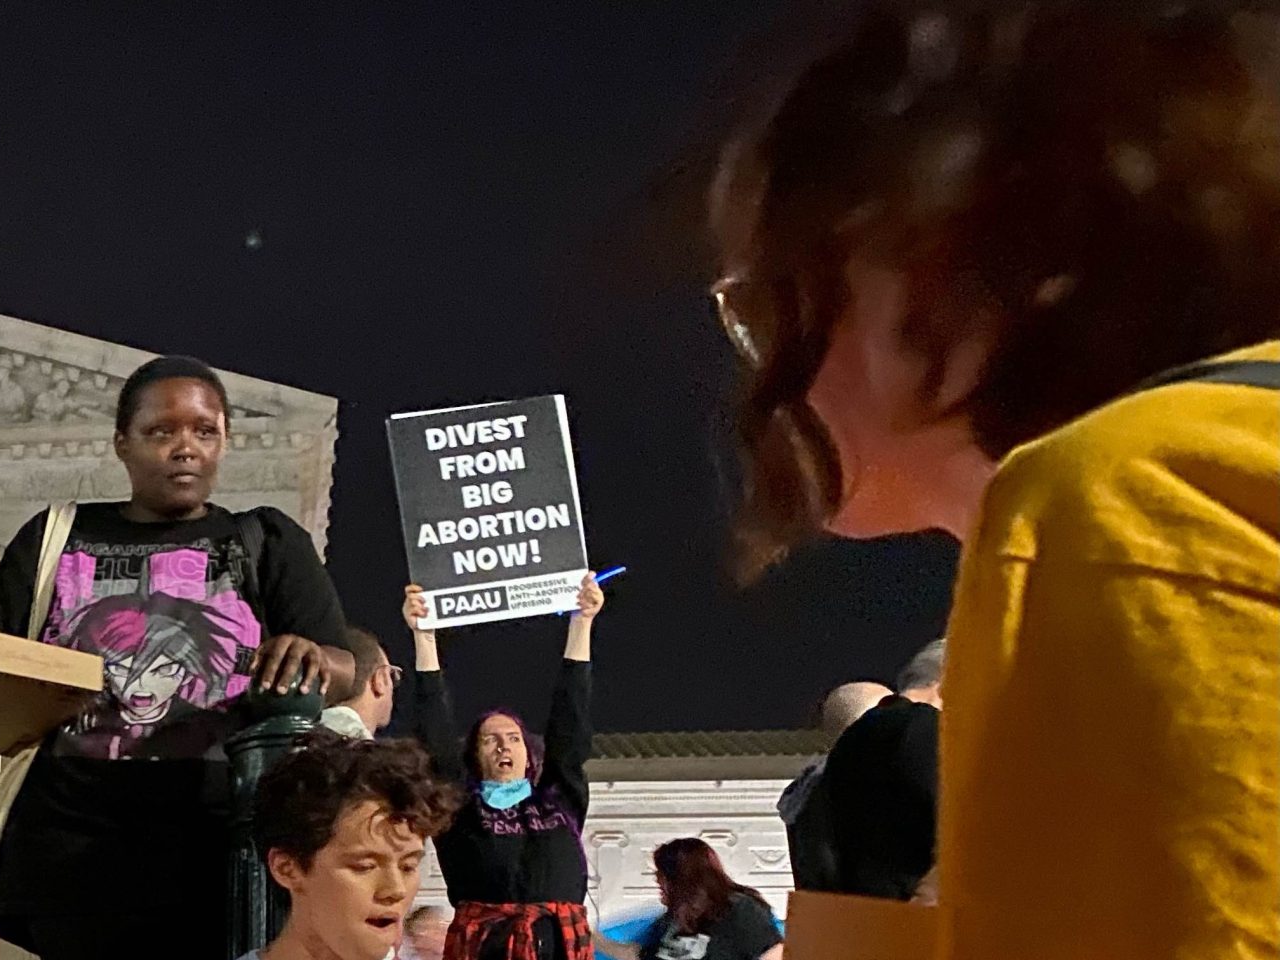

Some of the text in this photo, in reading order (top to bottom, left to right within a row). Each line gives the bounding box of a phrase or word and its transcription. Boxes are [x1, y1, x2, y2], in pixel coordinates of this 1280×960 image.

[425, 415, 527, 451] DIVEST
[439, 447, 526, 480] FROM
[461, 481, 513, 509] BIG
[417, 504, 570, 548] ABORTION
[453, 539, 542, 575] NOW!
[508, 577, 568, 592] PROGRESSIVE
[510, 585, 580, 601] ANTI-ABORTION
[440, 590, 502, 615] PAAU
[510, 597, 552, 610] UPRISING
